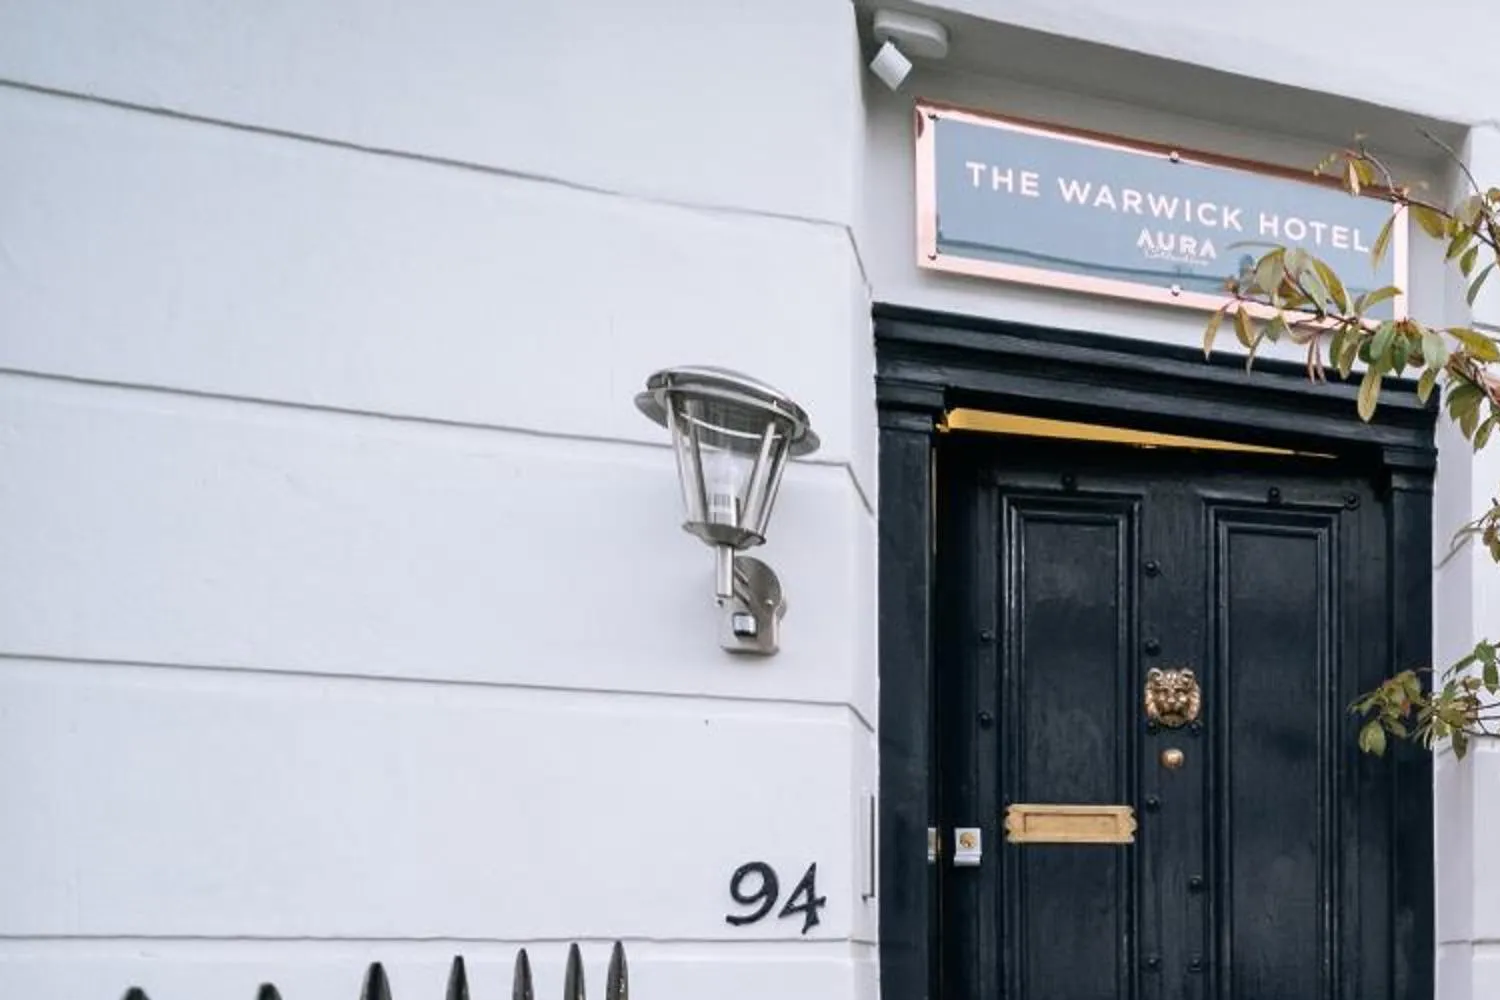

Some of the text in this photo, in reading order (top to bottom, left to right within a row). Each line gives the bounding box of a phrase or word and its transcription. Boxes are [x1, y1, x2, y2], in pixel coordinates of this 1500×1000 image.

[966, 162, 1369, 253] THE WARWICK HOTEL
[1136, 227, 1217, 260] AURA
[725, 861, 826, 934] 94
